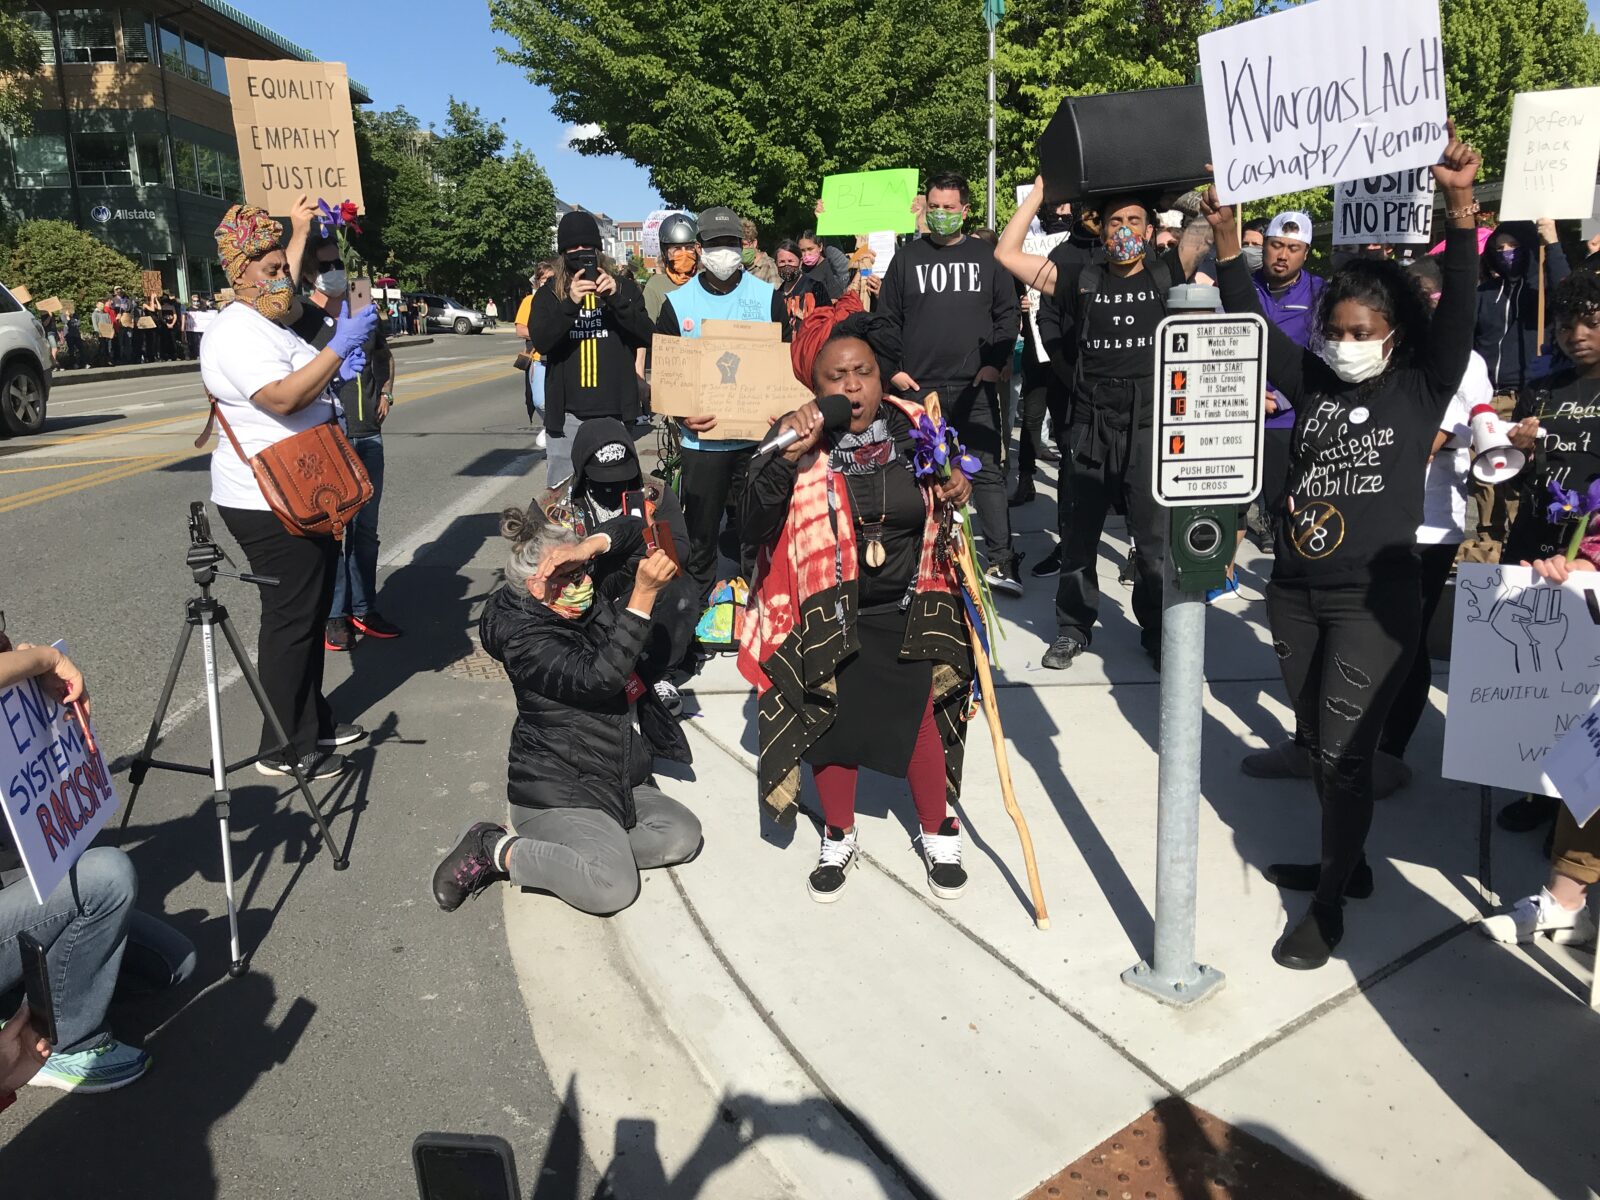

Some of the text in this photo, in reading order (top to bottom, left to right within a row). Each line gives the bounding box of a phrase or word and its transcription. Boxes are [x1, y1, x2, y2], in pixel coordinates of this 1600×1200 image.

[247, 76, 335, 100] EQUALITY
[1524, 111, 1585, 133] Defend
[251, 126, 340, 150] EMPATHY
[1528, 140, 1570, 155] Black
[1523, 158, 1568, 172] Lives
[261, 163, 348, 190] JUSTICE
[113, 209, 156, 220] Allstate
[1342, 201, 1432, 236] NO PEACE
[916, 263, 981, 294] VOTE
[579, 307, 602, 318] LACK
[574, 319, 602, 328] LIVES
[1113, 316, 1135, 325] TO
[569, 329, 609, 339] MATTER
[1197, 325, 1251, 336] START CROSSING
[1208, 338, 1239, 347] Watch For
[1211, 348, 1236, 357] Vehicles
[1202, 362, 1244, 373] DON'T START
[1200, 374, 1246, 384] Finish Crossing
[1215, 384, 1237, 393] Started
[1195, 398, 1249, 408] TIME REMAINING
[1194, 408, 1249, 419] To Finish Crossing
[1200, 436, 1243, 446] DON'T CROSS
[1544, 432, 1592, 452] Don't
[1180, 465, 1236, 475] PUSH BUTTON
[1188, 481, 1228, 491] TO CROSS
[1297, 470, 1384, 497] Mobilize
[1470, 686, 1550, 703] BEAUTIFUL
[36, 747, 112, 862] RACISM!
